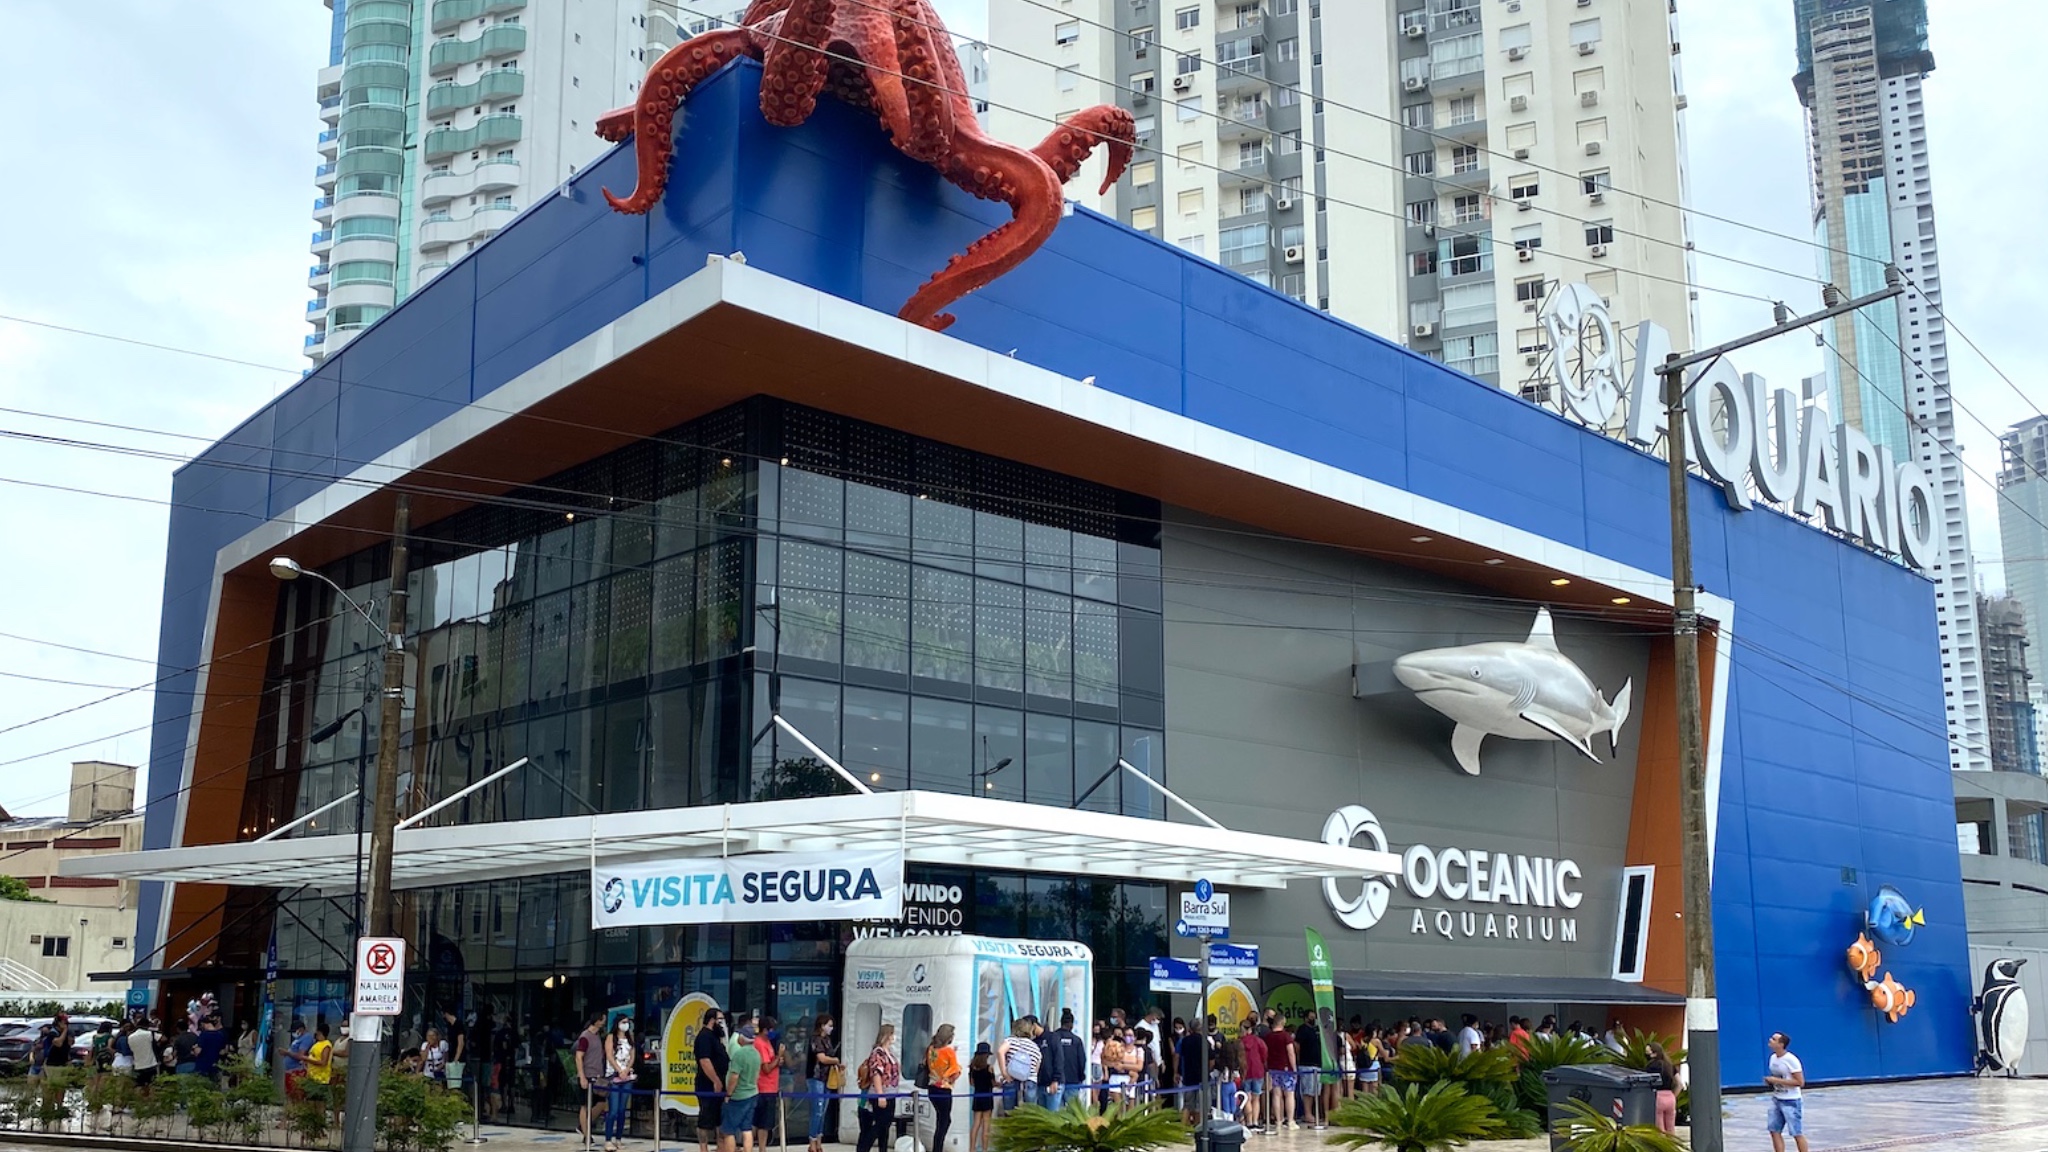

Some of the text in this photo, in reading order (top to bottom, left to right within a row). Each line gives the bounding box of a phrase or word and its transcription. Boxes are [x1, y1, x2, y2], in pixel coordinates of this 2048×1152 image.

[1627, 320, 1940, 569] AQUÁRIO
[1402, 844, 1583, 909] OCEANIC
[632, 868, 882, 908] VISITA SEGURA
[1184, 901, 1226, 915] Barra Sul
[1410, 908, 1577, 942] AQUARIUM
[972, 940, 1073, 957] VISITA SEGURA
[857, 970, 885, 980] VISITA
[360, 982, 398, 991] NA LINHA
[856, 981, 885, 990] SEGURA
[906, 985, 932, 993] OCEANIC
[359, 994, 397, 1003] AMARELA
